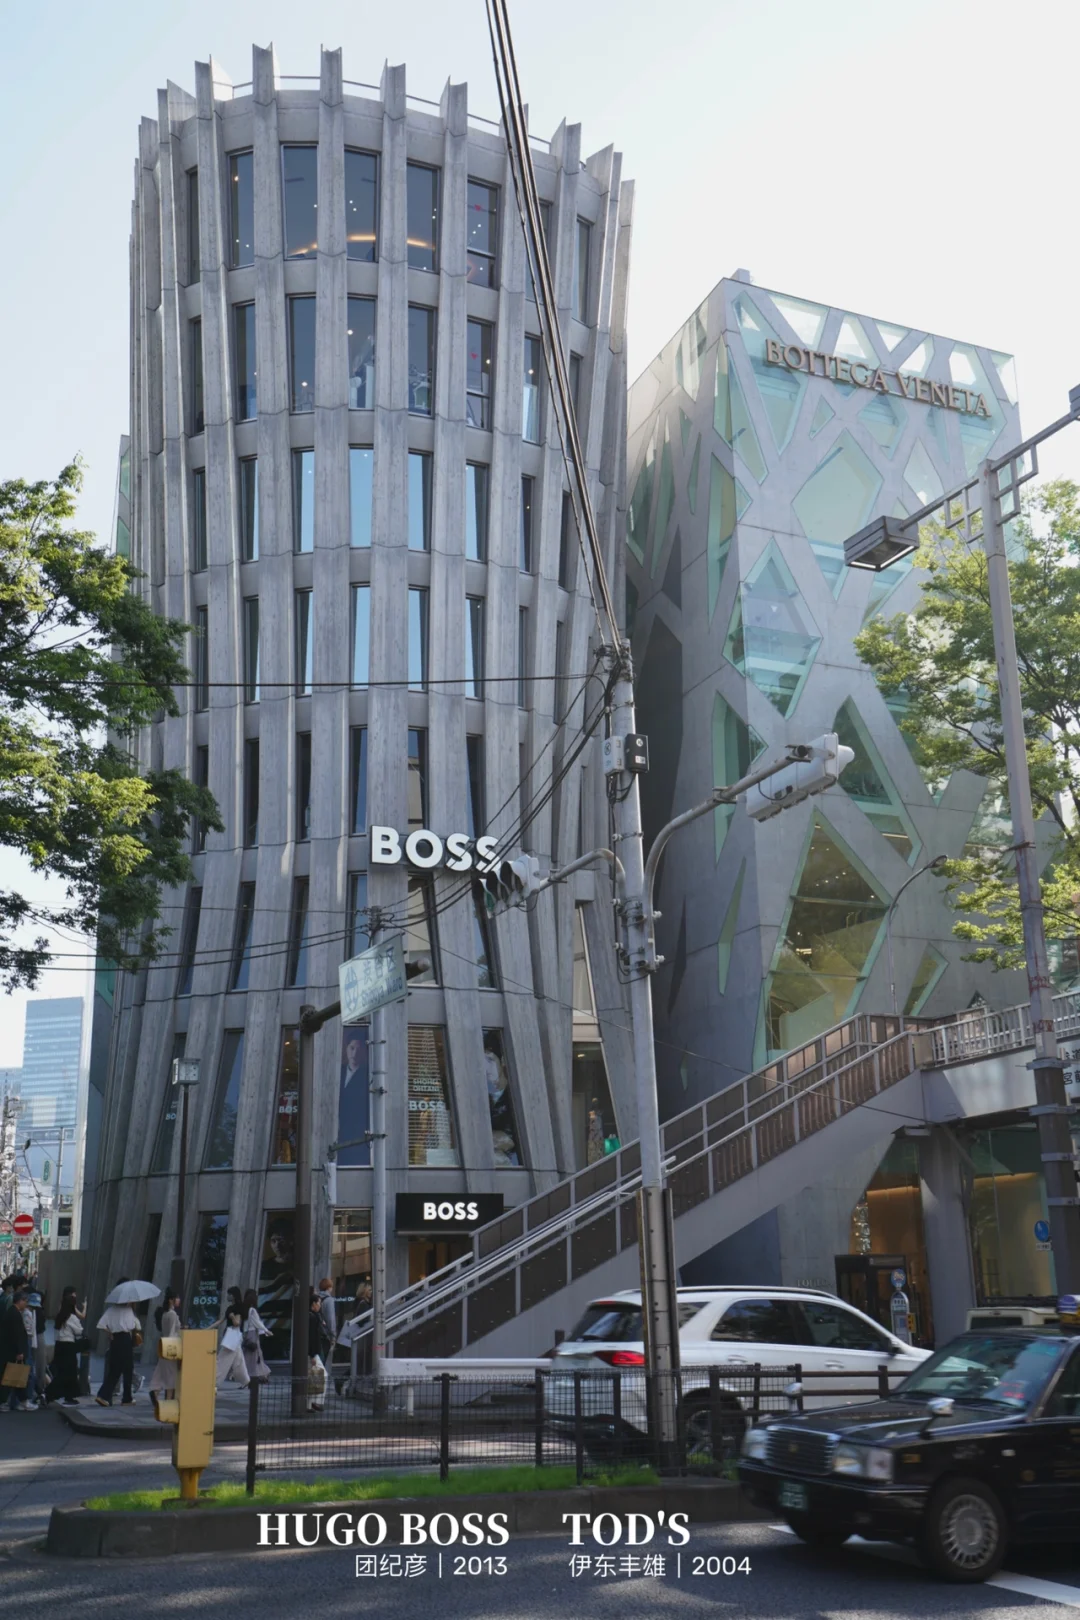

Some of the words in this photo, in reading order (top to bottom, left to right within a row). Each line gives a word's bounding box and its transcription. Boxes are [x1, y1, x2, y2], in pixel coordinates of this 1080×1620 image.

[765, 338, 890, 391] BOTTEGA
[894, 371, 992, 418] VENETA
[371, 825, 501, 873] BOSS
[408, 1100, 446, 1111] BOSS
[423, 1201, 479, 1221] BOSS
[193, 1296, 219, 1305] BOSS
